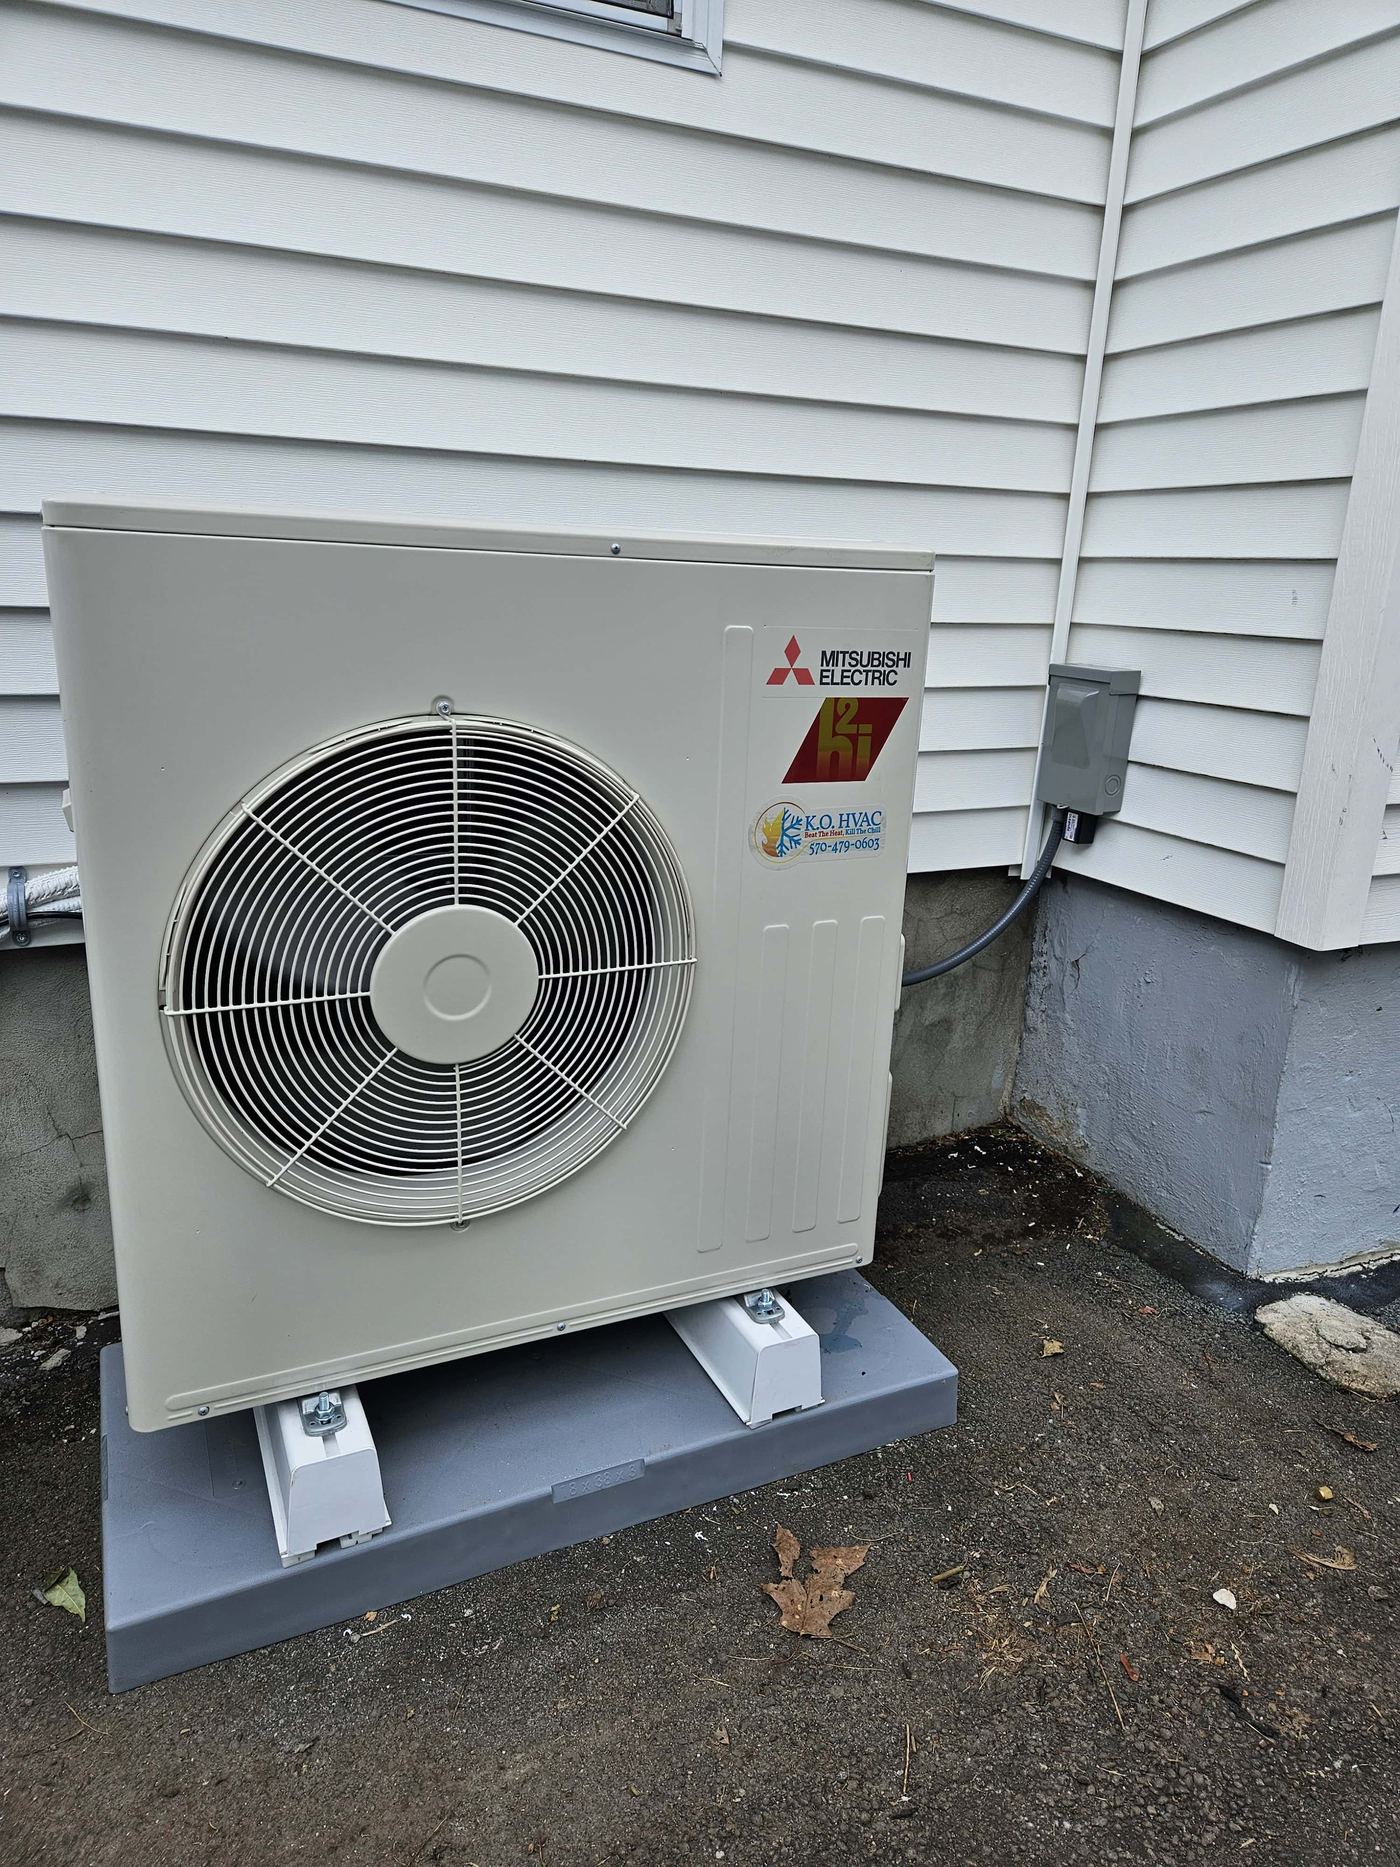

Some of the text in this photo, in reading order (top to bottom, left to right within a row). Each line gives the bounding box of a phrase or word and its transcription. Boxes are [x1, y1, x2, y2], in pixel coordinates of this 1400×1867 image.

[820, 650, 911, 668] MITSUBISHI
[819, 669, 898, 686] ELECTRIC
[804, 811, 882, 831] K.O. HVAC
[809, 837, 879, 855] 570-479-0603
